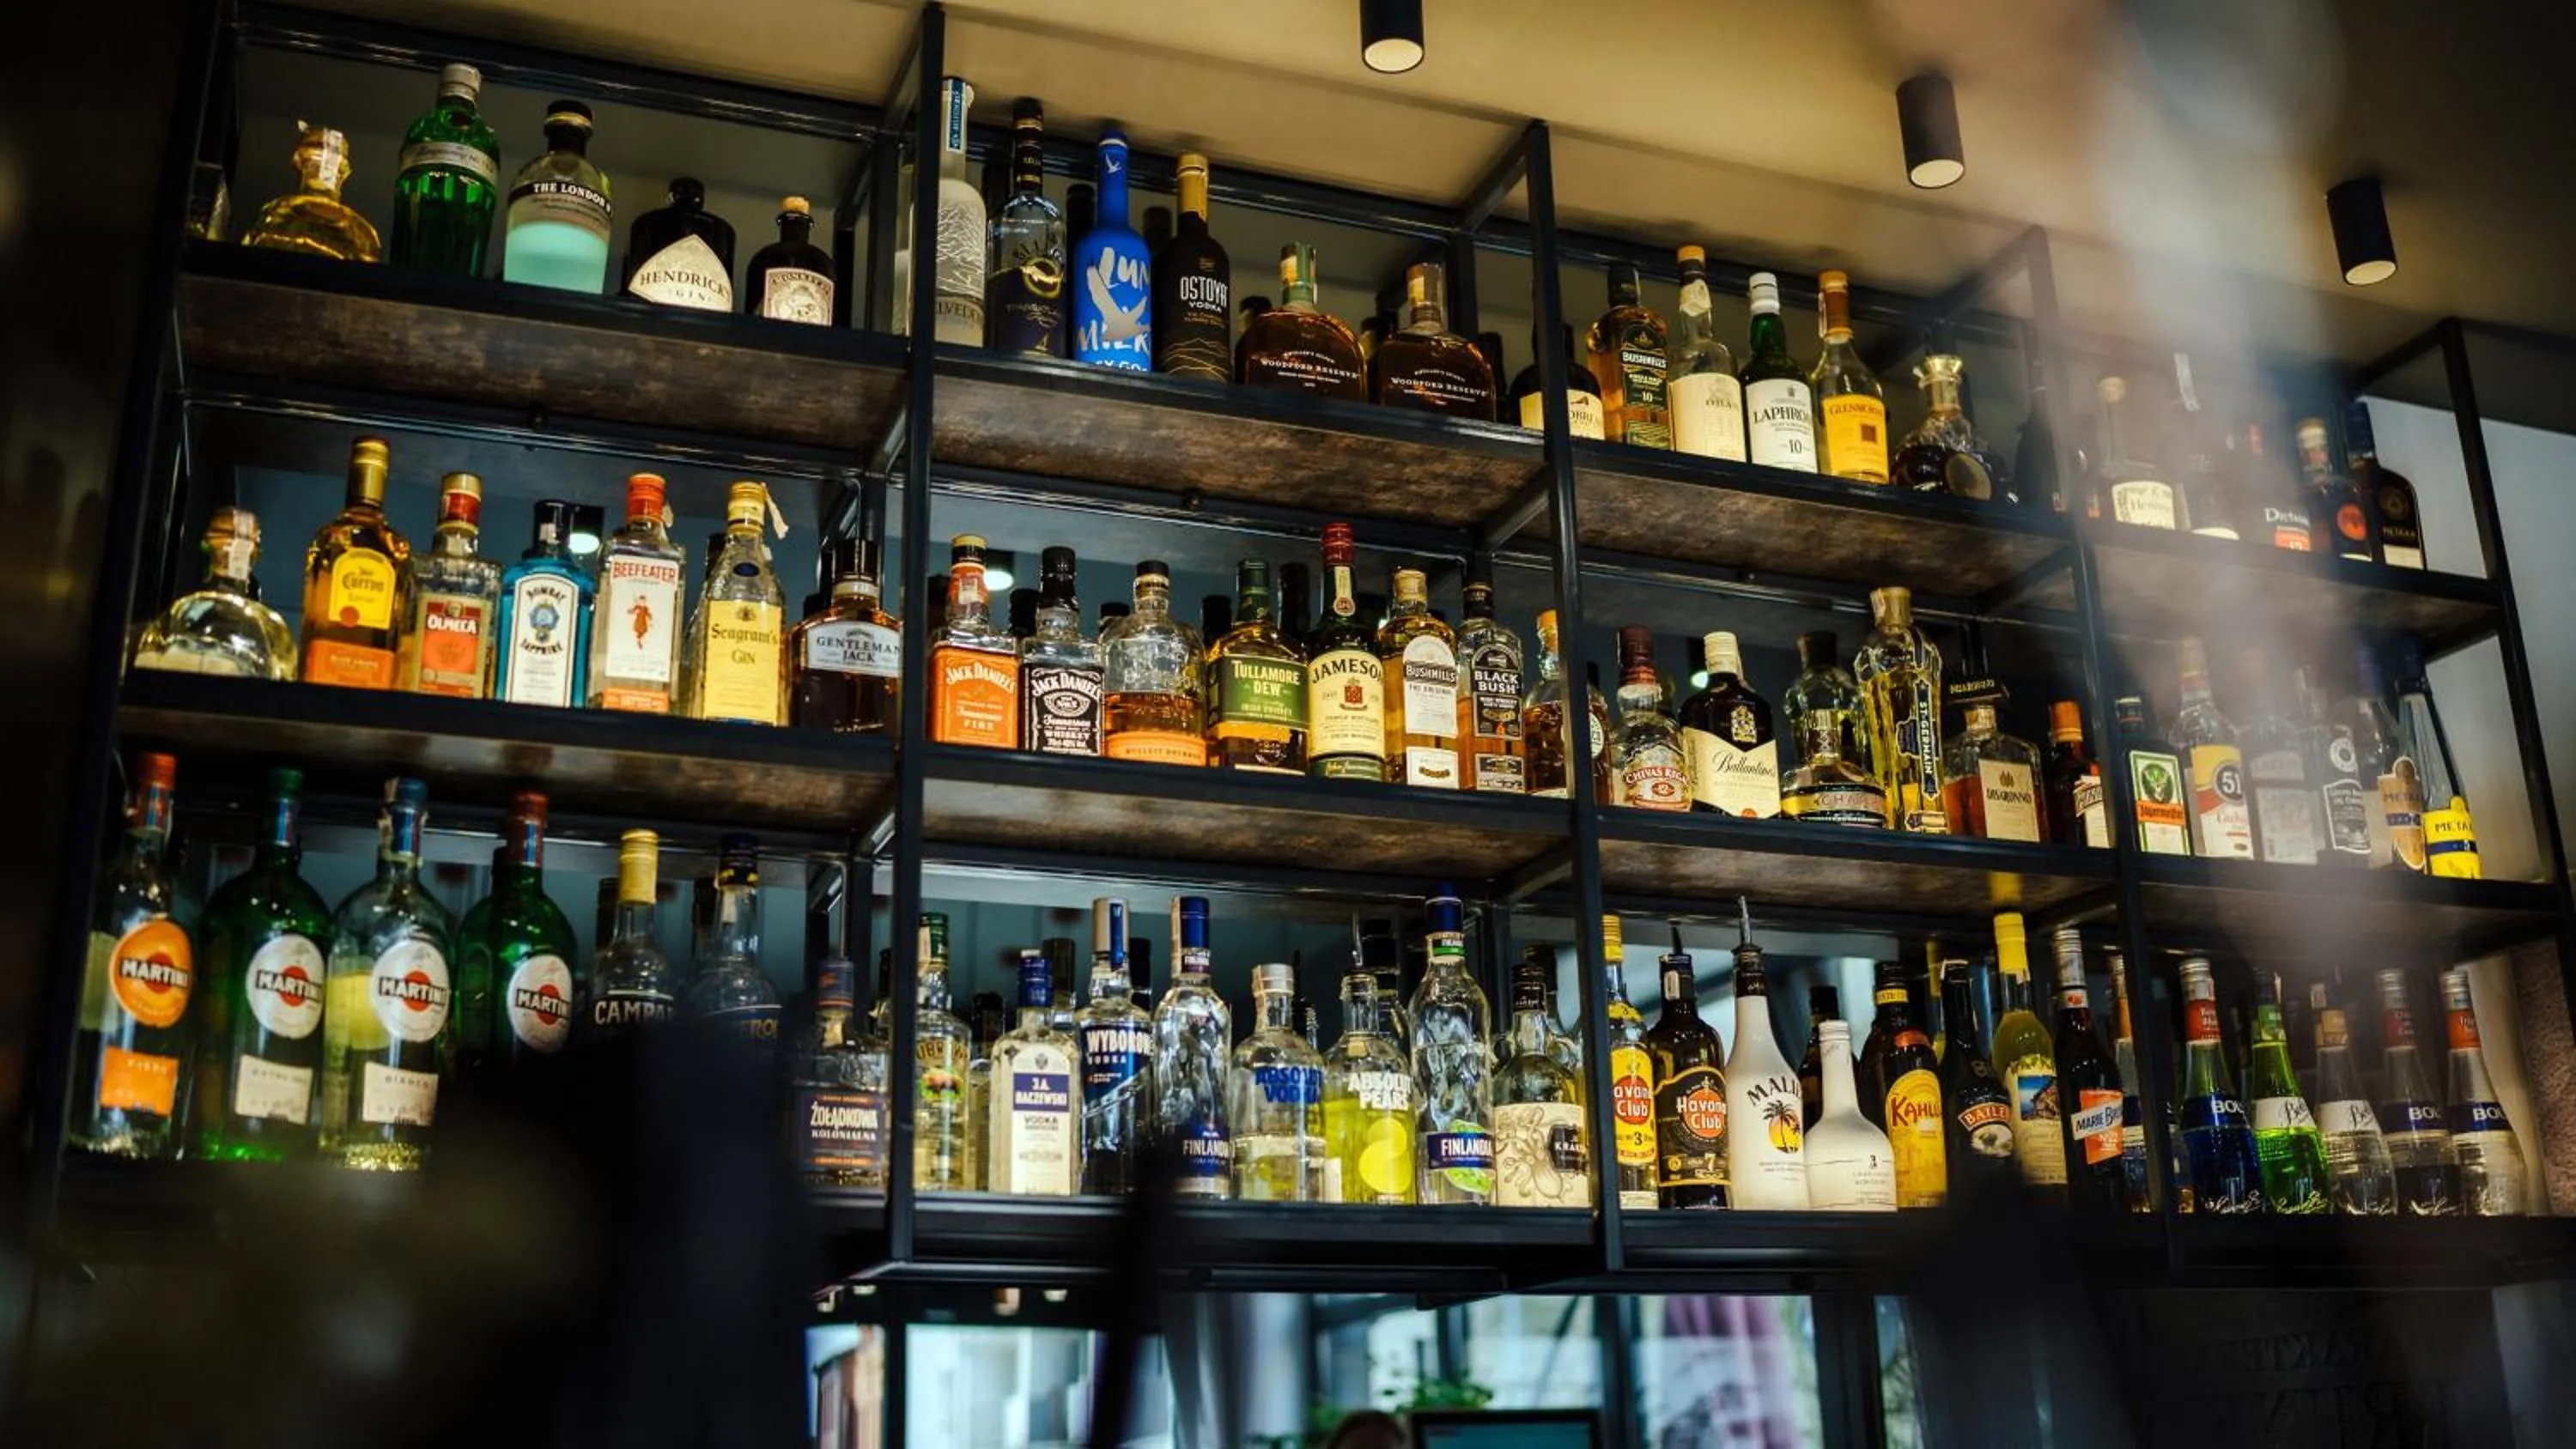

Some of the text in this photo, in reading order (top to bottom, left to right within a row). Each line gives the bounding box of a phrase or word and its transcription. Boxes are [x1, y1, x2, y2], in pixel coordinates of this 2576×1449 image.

[533, 182, 557, 193] THE
[561, 183, 605, 208] LONDON
[1181, 276, 1228, 307] OSTOYA
[1189, 301, 1221, 313] VODKA
[1260, 357, 1313, 372] WOODFORD
[1315, 364, 1358, 379] RESERVE
[1391, 377, 1443, 390] WOODFORD
[1446, 383, 1488, 397] RESERVE
[1641, 391, 1653, 403] 10
[1789, 439, 1802, 454] 10
[343, 571, 385, 591] Cuervo
[613, 561, 676, 583] BEEFEATER
[526, 586, 567, 602] BOMBAY
[427, 615, 477, 634] OLMECA
[712, 623, 779, 645] Seagram's
[520, 639, 562, 654] SAPPHIRE
[817, 636, 902, 653] GENTLEMAN
[732, 649, 756, 664] GIN
[842, 651, 875, 663] JACK
[946, 665, 973, 685] JACK
[1231, 660, 1300, 685] TULLAMORE
[1406, 664, 1455, 682] BUSHMILLS
[1474, 670, 1518, 683] BLACK
[1031, 676, 1059, 696] JACK
[1253, 681, 1282, 696] DEW
[1478, 681, 1517, 694] BUSH
[964, 719, 994, 730] FIRE
[1625, 767, 1662, 785] CHIVAS
[2221, 773, 2242, 794] 51
[1986, 789, 2032, 803] DISARONNO
[122, 958, 190, 988] MARTINI
[381, 978, 447, 1003] MARTINI
[1087, 1055, 1127, 1064] VODKA
[1255, 1065, 1322, 1086] ABSOLUT
[1617, 1100, 1649, 1117] Club
[1676, 1096, 1727, 1114] Havana
[1024, 1116, 1059, 1125] VODKA
[1691, 1113, 1722, 1130] Club
[2075, 1113, 2104, 1131] MARIE
[1634, 1132, 1643, 1146] 3
[1704, 1153, 1716, 1171] 7
